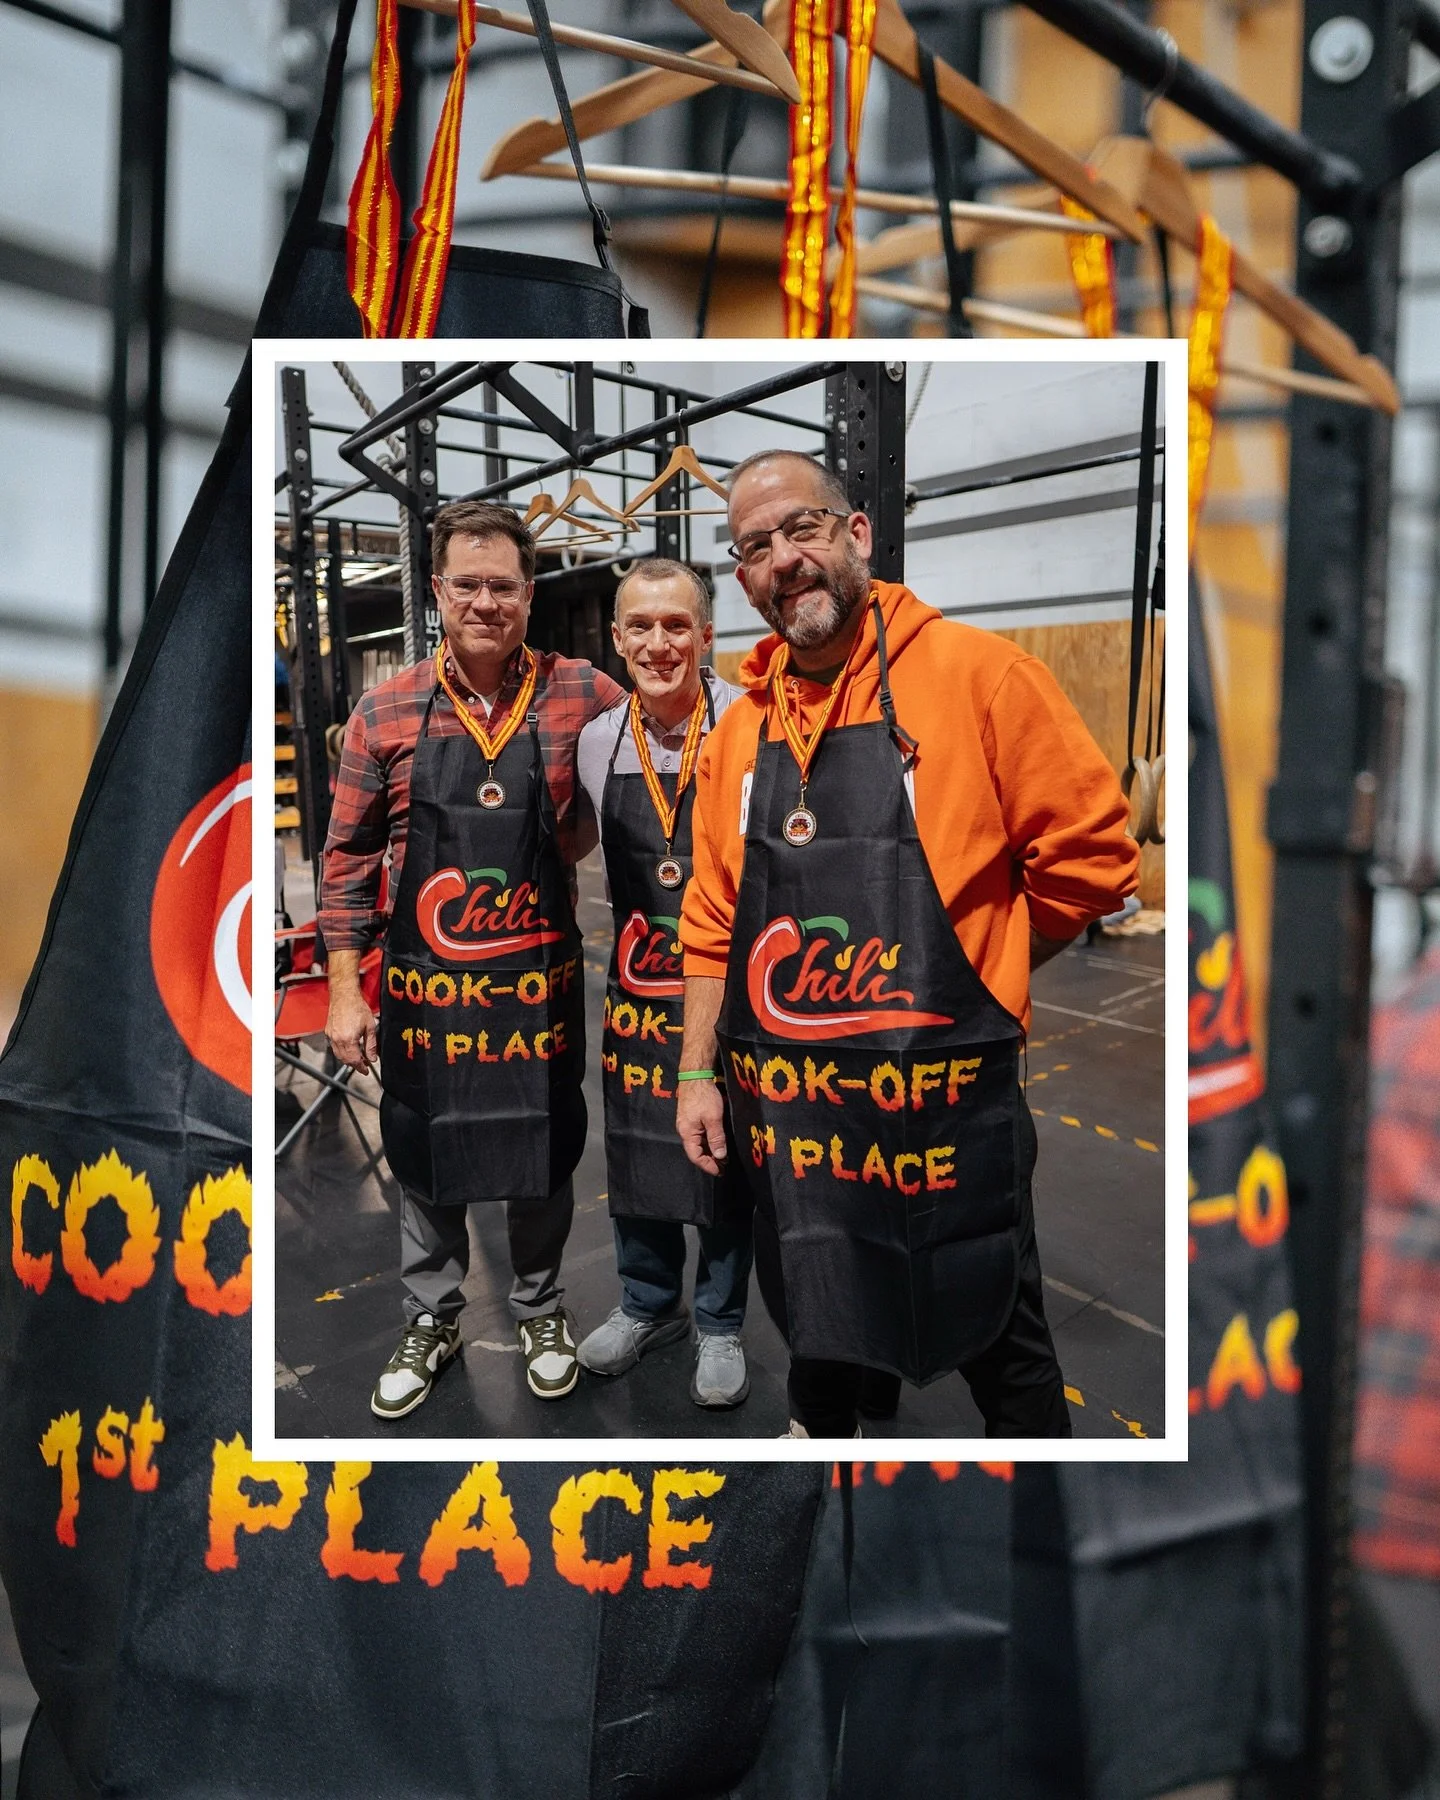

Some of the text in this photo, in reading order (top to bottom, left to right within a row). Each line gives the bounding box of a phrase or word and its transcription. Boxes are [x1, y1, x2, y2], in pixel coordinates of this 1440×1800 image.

[416, 867, 565, 962] Chili
[388, 957, 576, 1009] COOK-OFF
[747, 914, 955, 1041] Chili
[402, 1021, 568, 1065] 1st PLACE
[731, 1050, 983, 1113] COOK-OFF
[789, 1132, 958, 1196] PLACE
[39, 1396, 727, 1595] 1st PLACE
